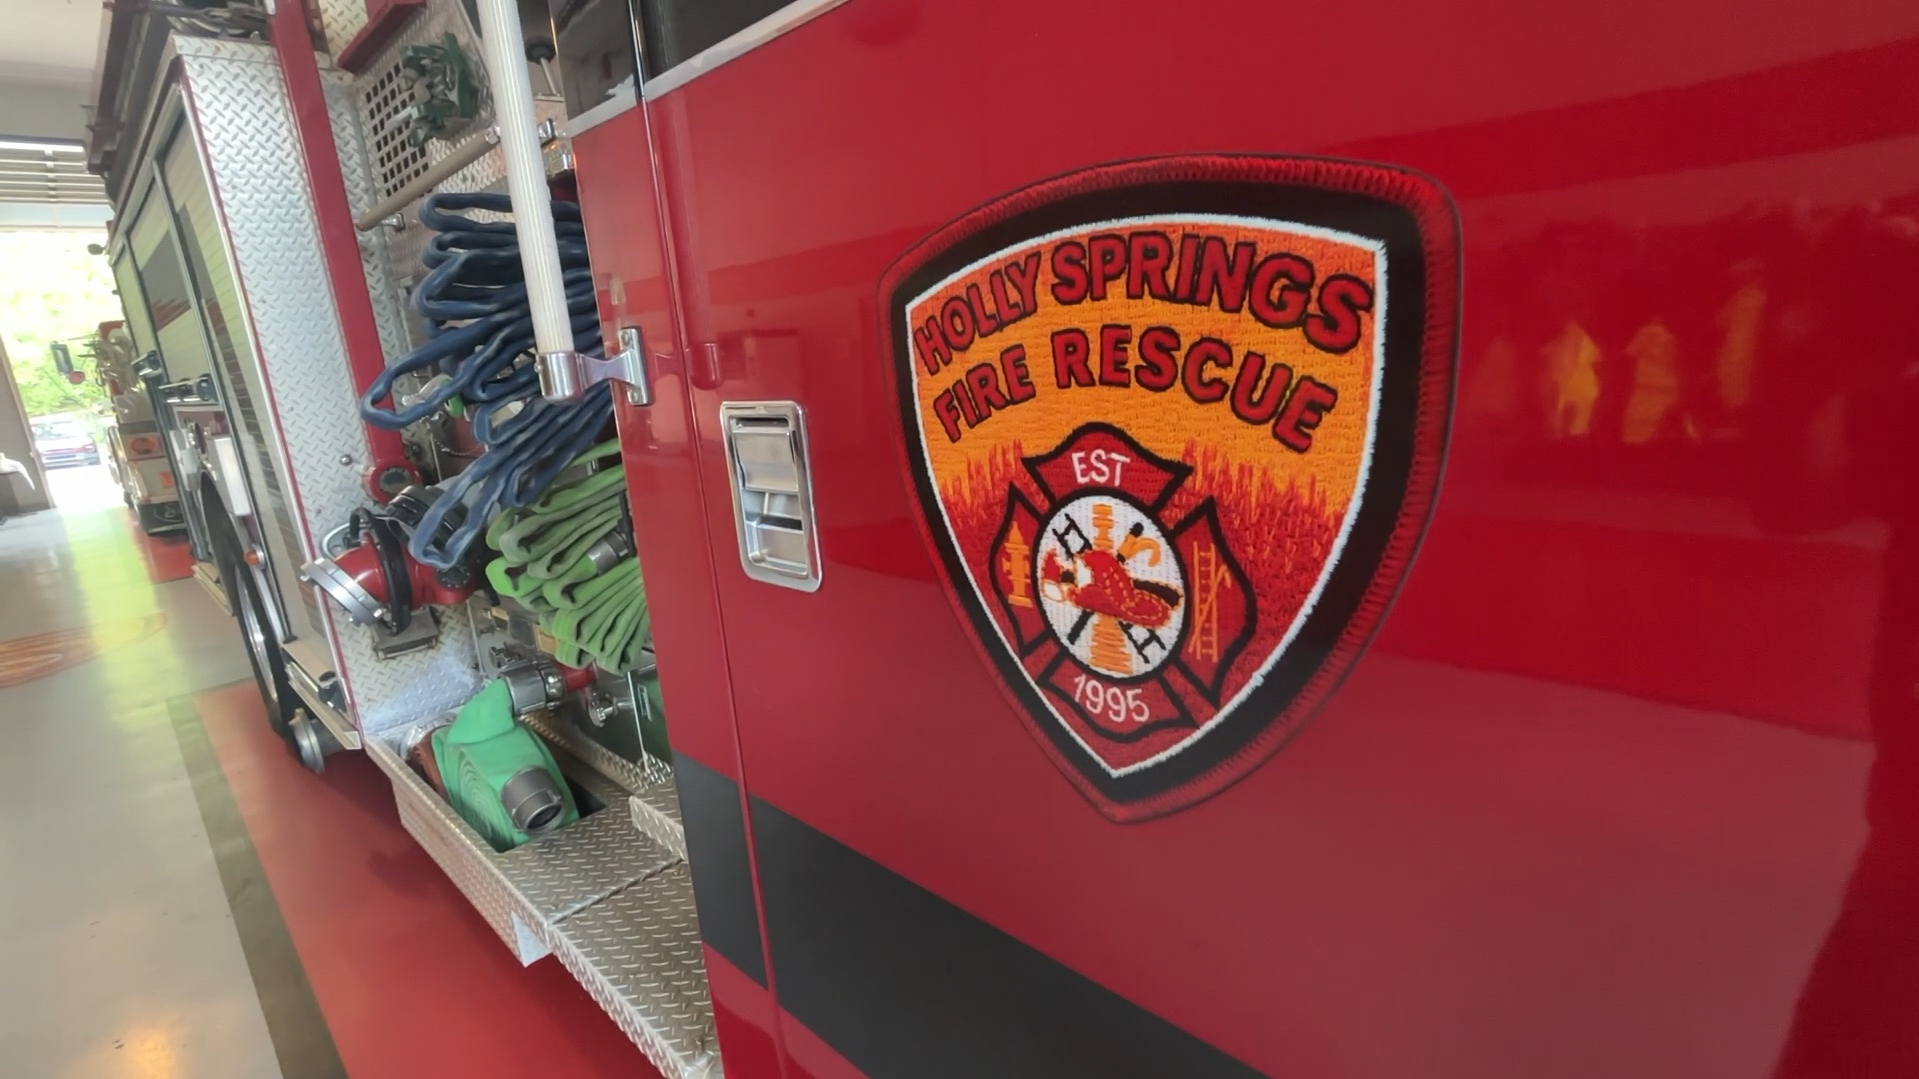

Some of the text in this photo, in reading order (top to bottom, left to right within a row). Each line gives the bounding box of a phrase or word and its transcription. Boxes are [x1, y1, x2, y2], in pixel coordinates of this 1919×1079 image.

[914, 231, 1374, 376] HOLLY SPRINGS
[933, 325, 1338, 453] FIRE RESCUE
[1071, 449, 1130, 487] EST
[1073, 673, 1150, 722] 1995
